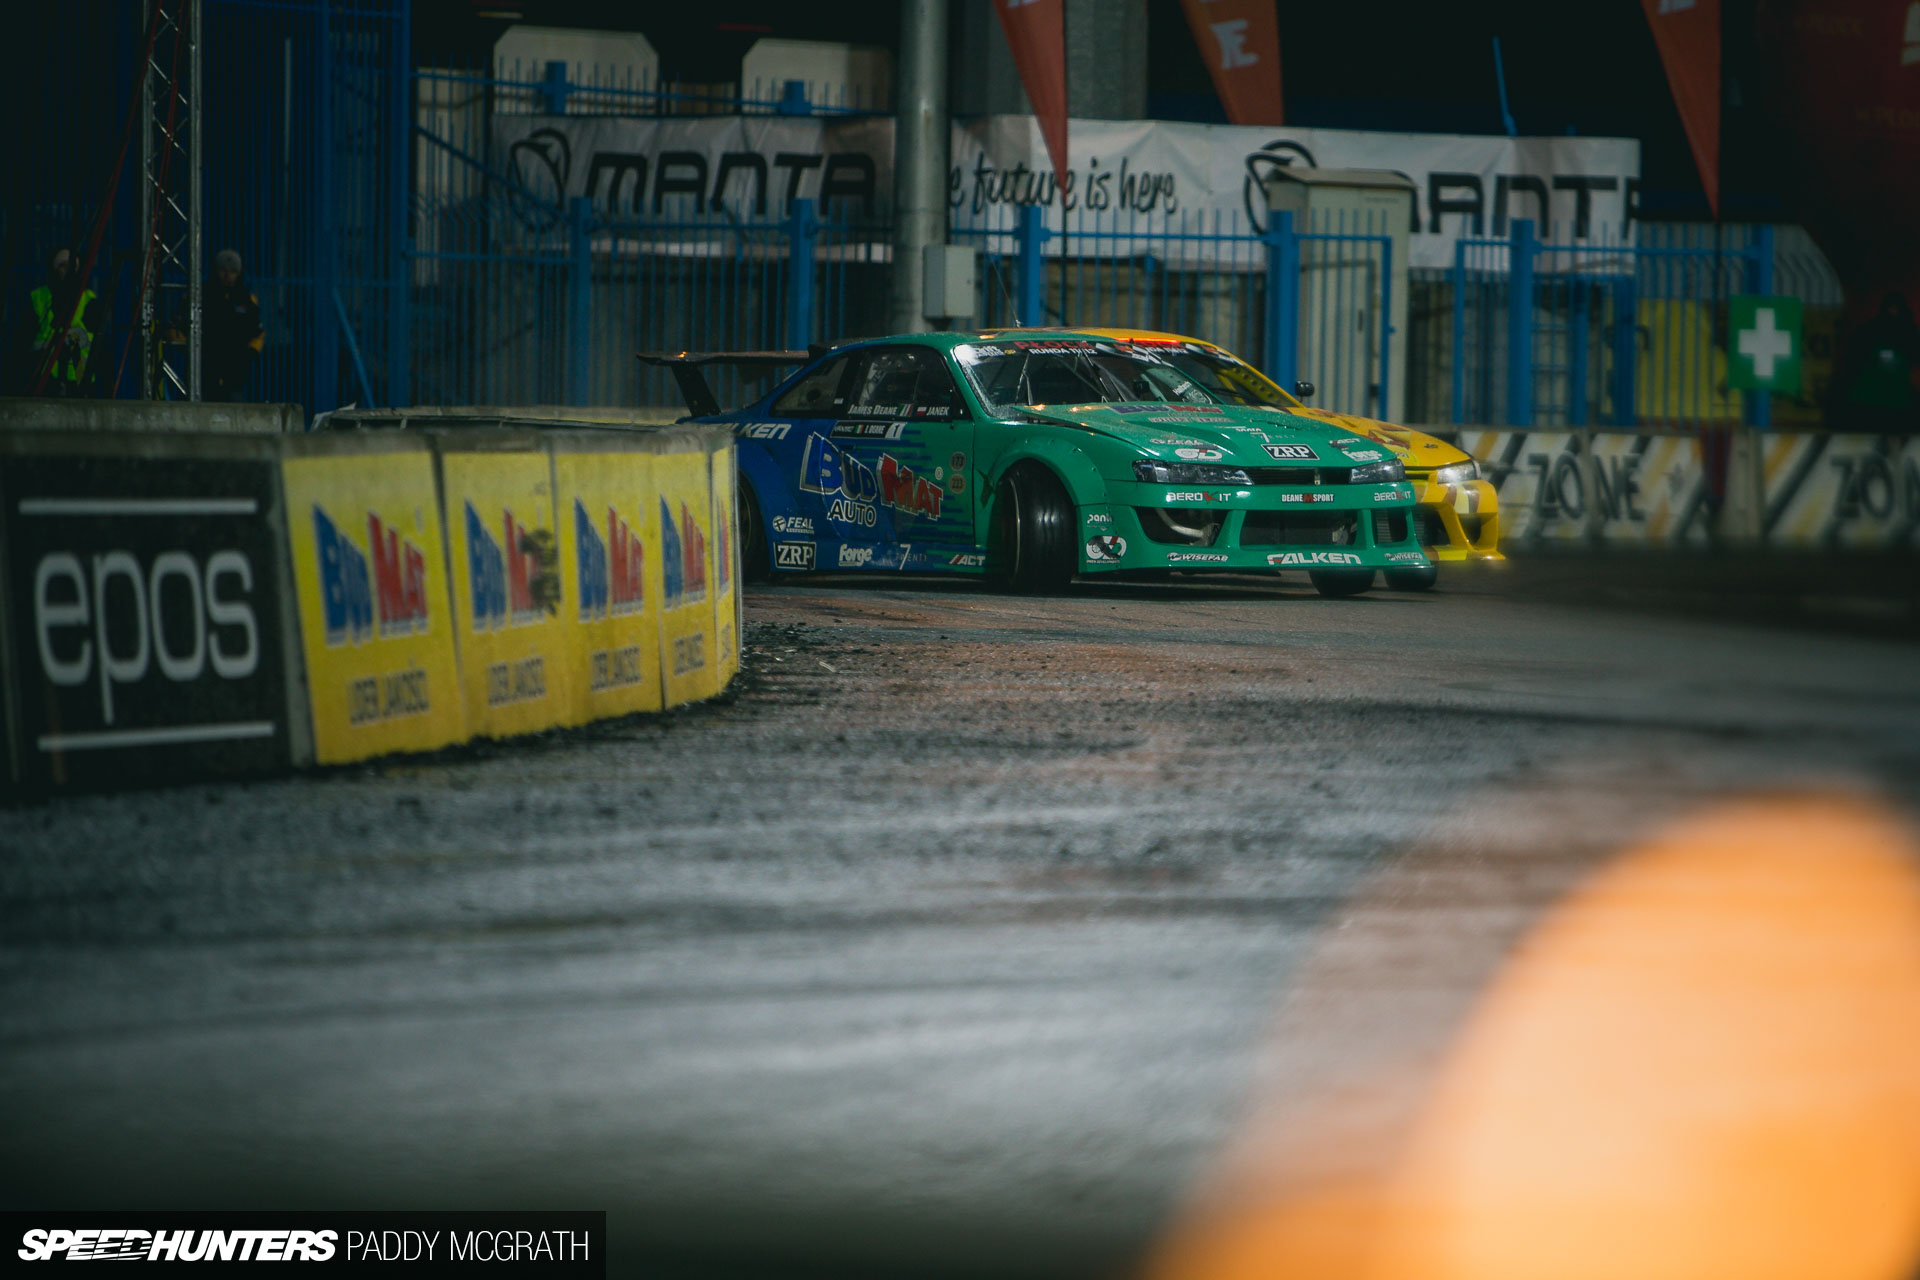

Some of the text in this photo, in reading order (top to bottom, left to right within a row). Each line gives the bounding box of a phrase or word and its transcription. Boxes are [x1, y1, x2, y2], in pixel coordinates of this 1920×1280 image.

[1085, 156, 1113, 210] is
[1118, 157, 1178, 215] here
[848, 403, 898, 416] JAMES DEANE
[926, 406, 950, 417] JANEK
[1267, 446, 1311, 458] ZRP
[828, 499, 877, 528] AUTO
[786, 516, 814, 531] FEAL
[777, 544, 814, 566] ZRP
[1266, 552, 1362, 566] FALKEN
[34, 551, 259, 725] epos
